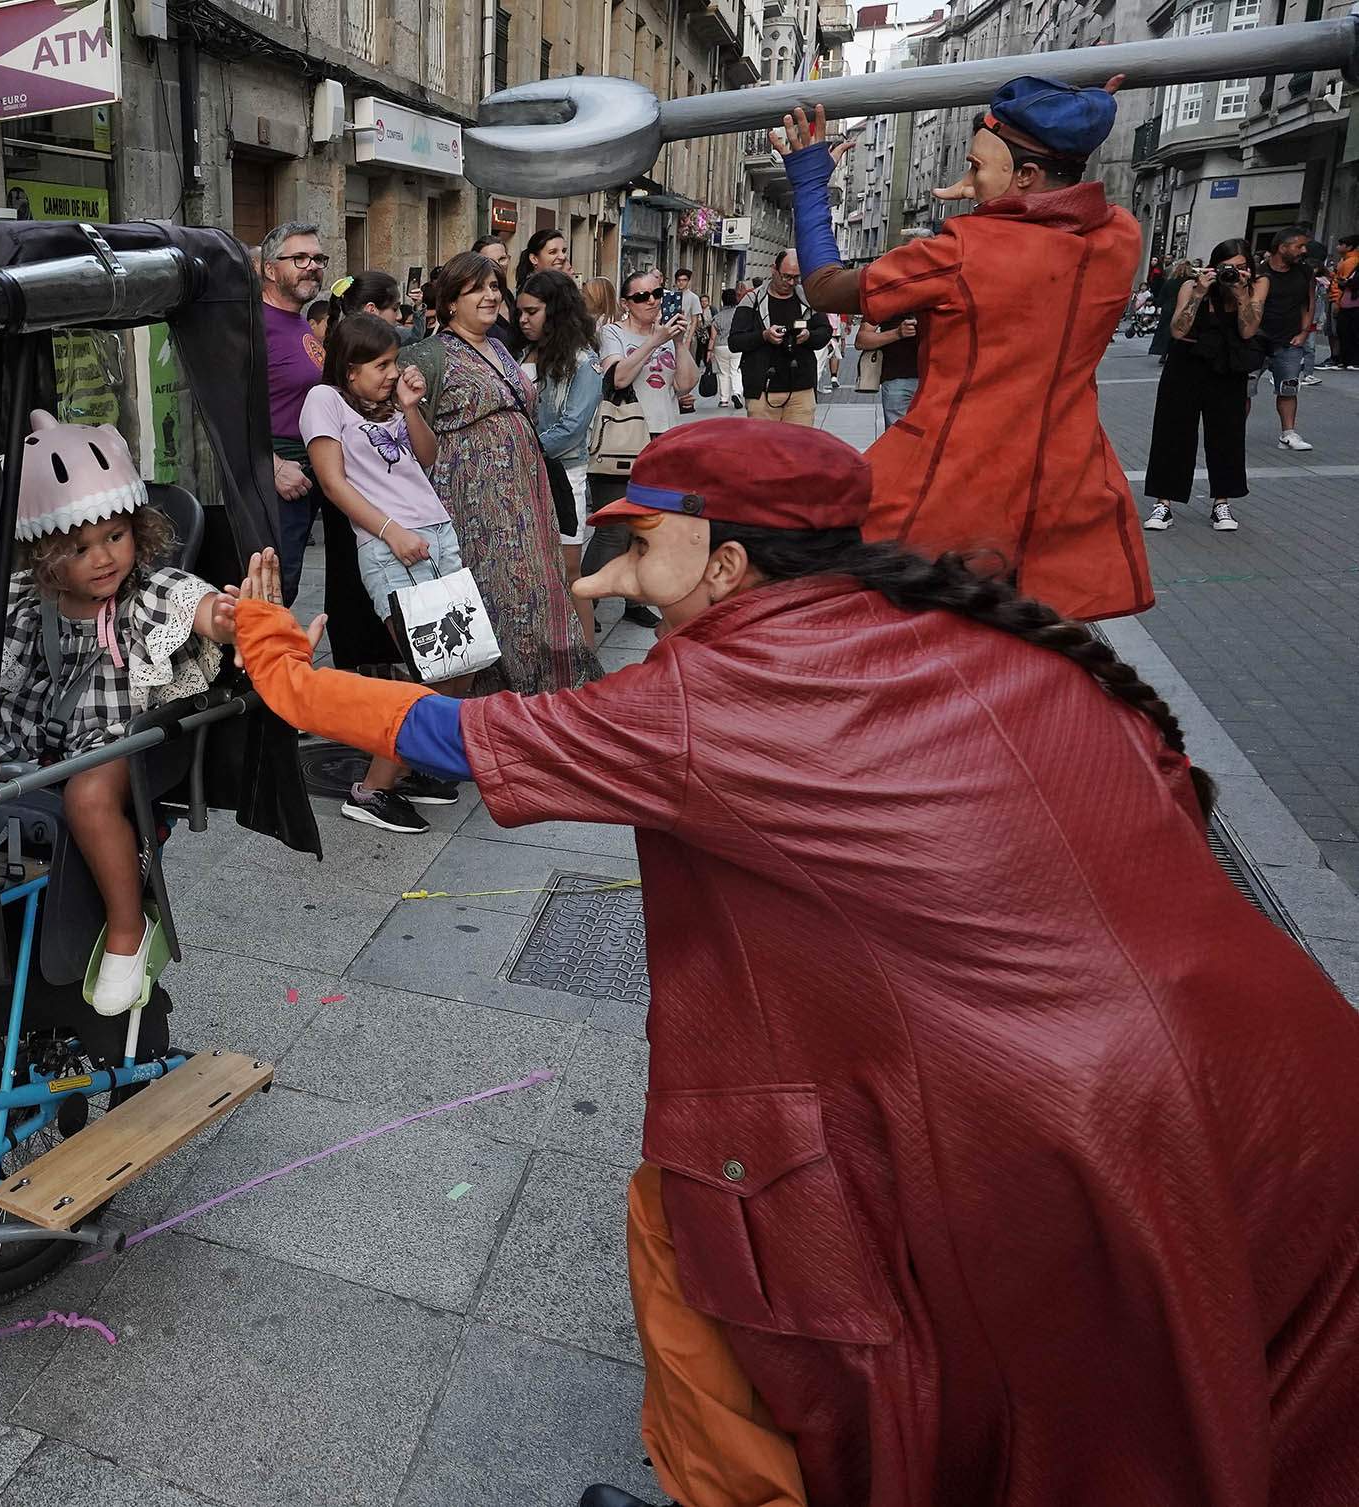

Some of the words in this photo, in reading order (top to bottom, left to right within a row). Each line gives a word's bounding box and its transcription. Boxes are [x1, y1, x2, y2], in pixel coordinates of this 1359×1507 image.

[32, 26, 108, 71] ATM
[2, 94, 28, 105] EURO
[43, 197, 70, 216] CAMBIO
[72, 199, 81, 217] DE
[82, 200, 99, 218] PILAS
